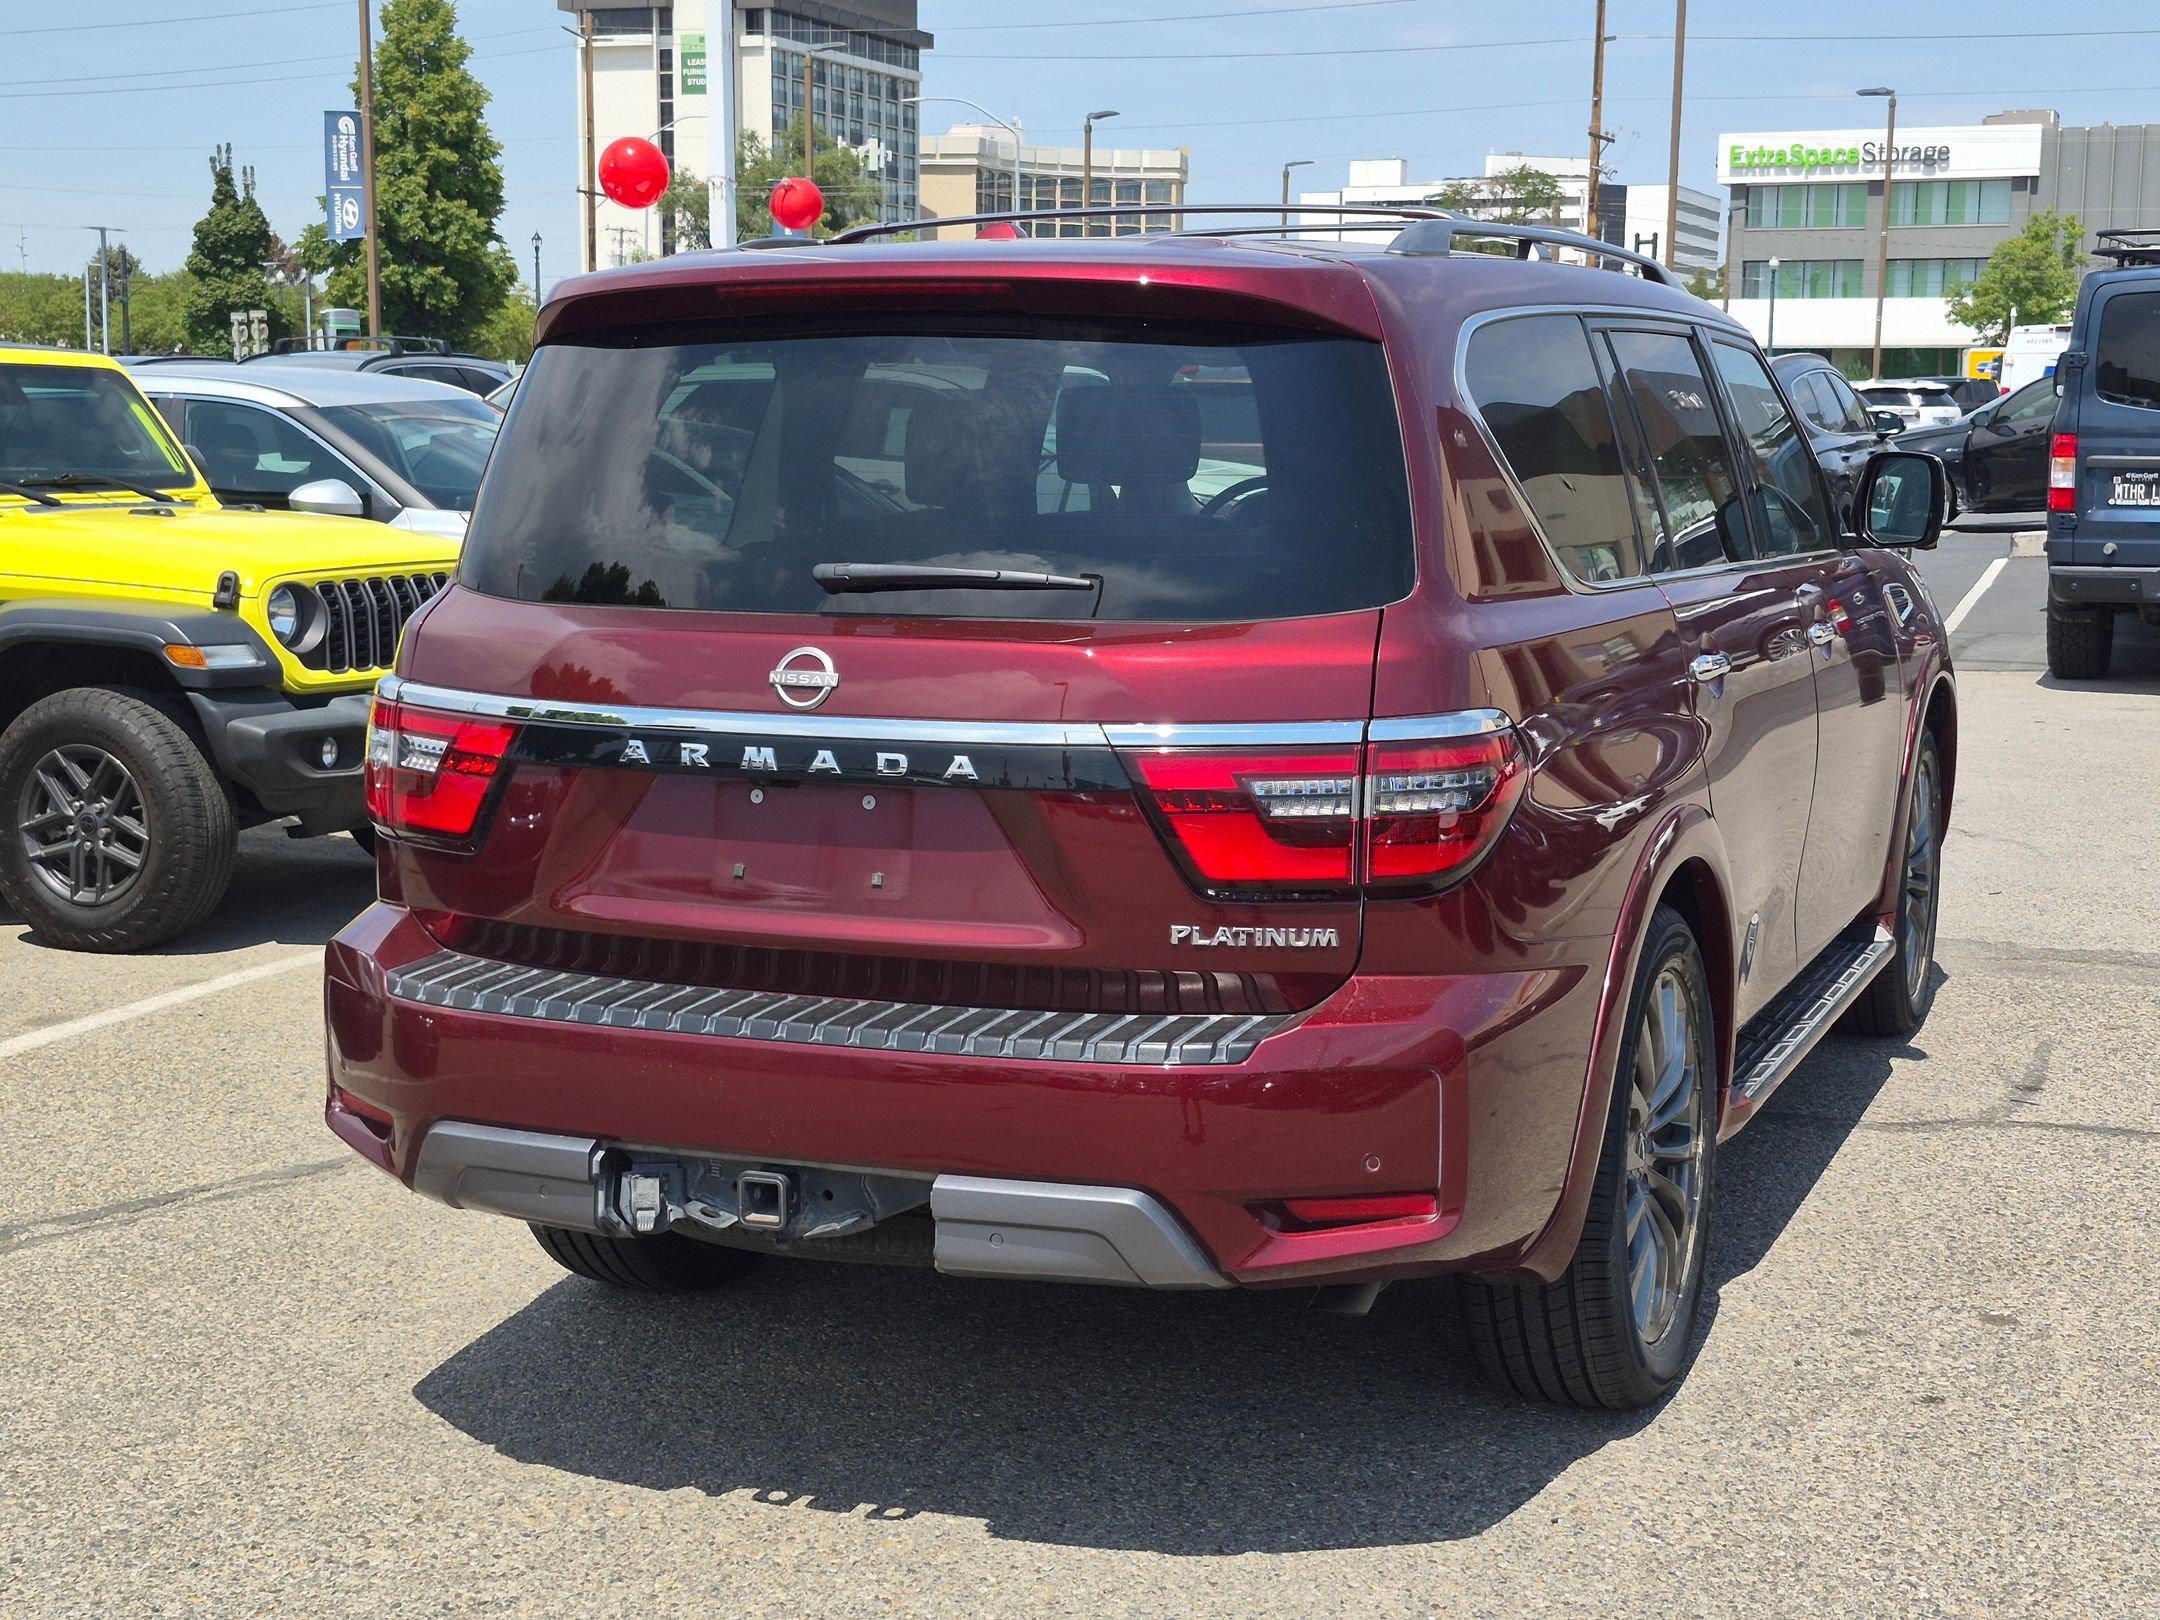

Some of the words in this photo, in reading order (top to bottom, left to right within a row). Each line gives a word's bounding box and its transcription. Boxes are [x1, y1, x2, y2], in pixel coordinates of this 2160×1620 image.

[338, 134, 350, 181] Hyundai
[350, 152, 359, 172] Garff
[1862, 142, 1950, 167] Storage
[334, 193, 342, 234] HYUNDAI
[2114, 483, 2145, 499] MTHR
[769, 673, 836, 686] NISSAN
[619, 739, 979, 780] ARMADA
[1170, 925, 1338, 947] PLATINUM
